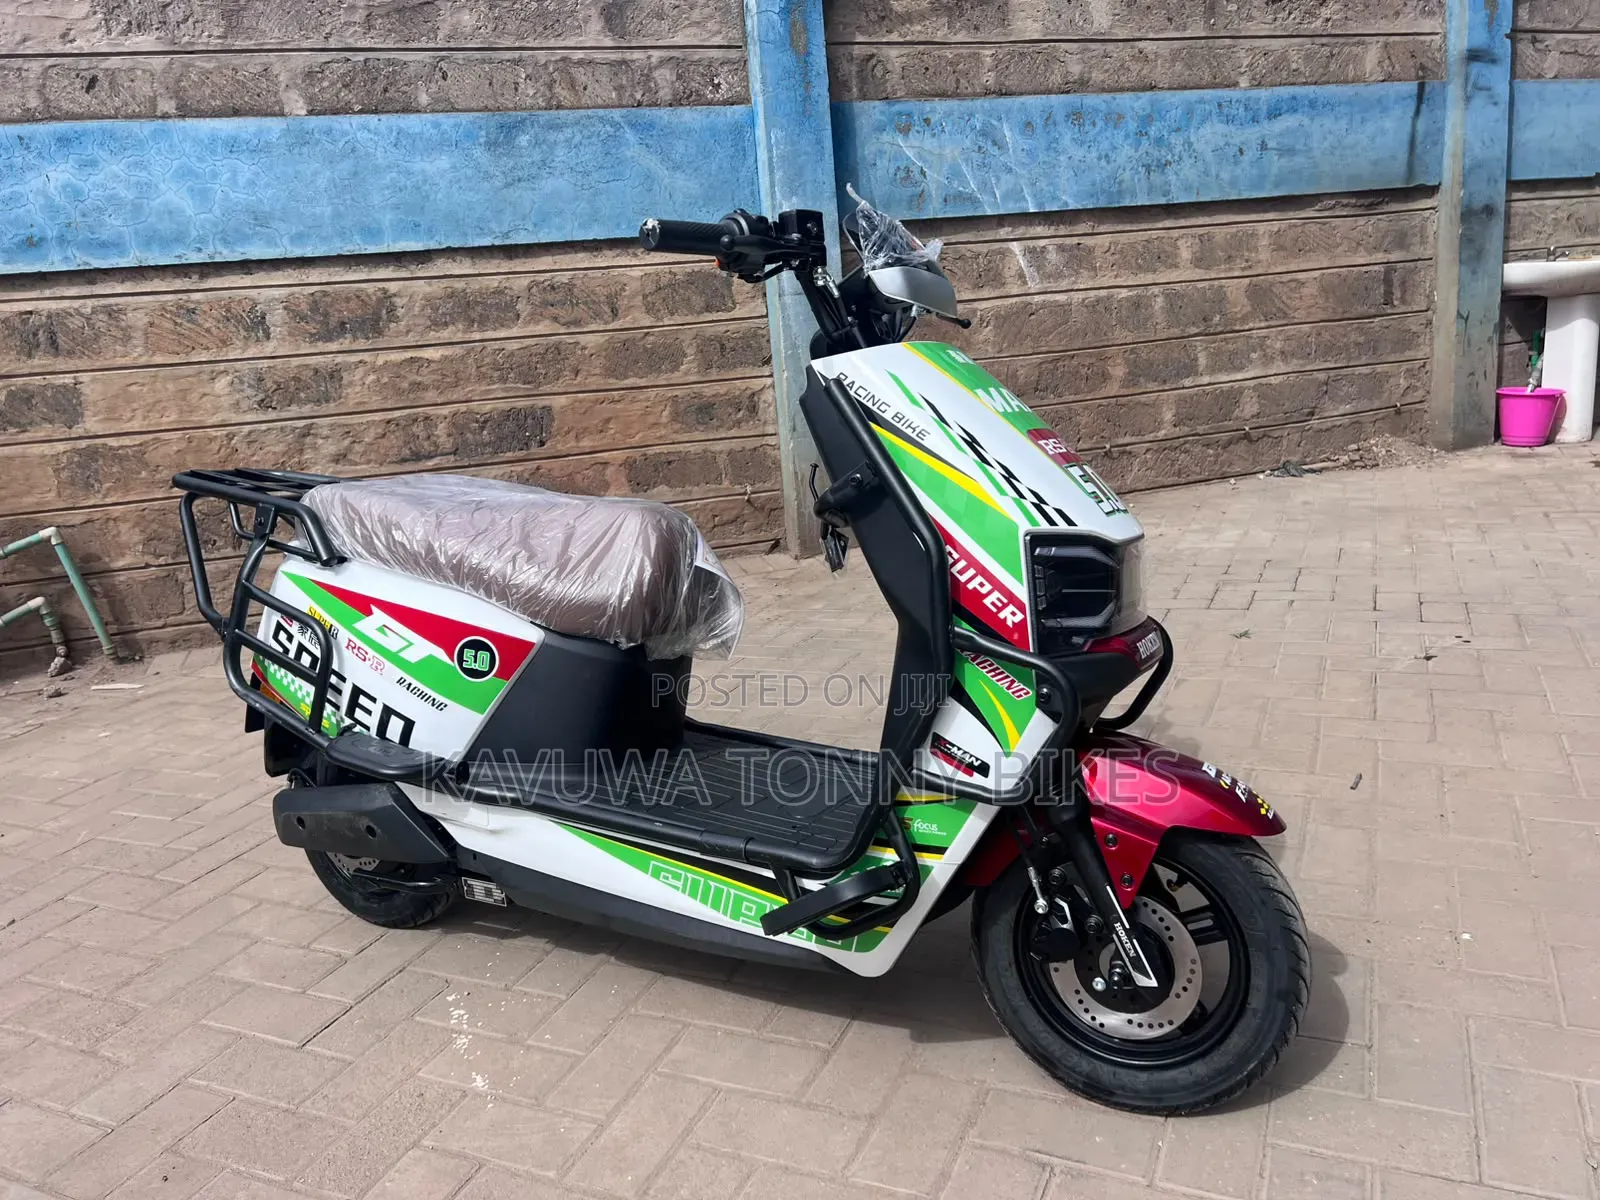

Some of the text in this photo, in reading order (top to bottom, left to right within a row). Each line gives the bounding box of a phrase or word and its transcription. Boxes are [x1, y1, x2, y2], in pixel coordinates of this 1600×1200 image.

[891, 411, 931, 441] BIKE
[945, 544, 1025, 629] SUPER
[462, 648, 491, 672] 5.0
[1113, 921, 1137, 957] HOKEN
